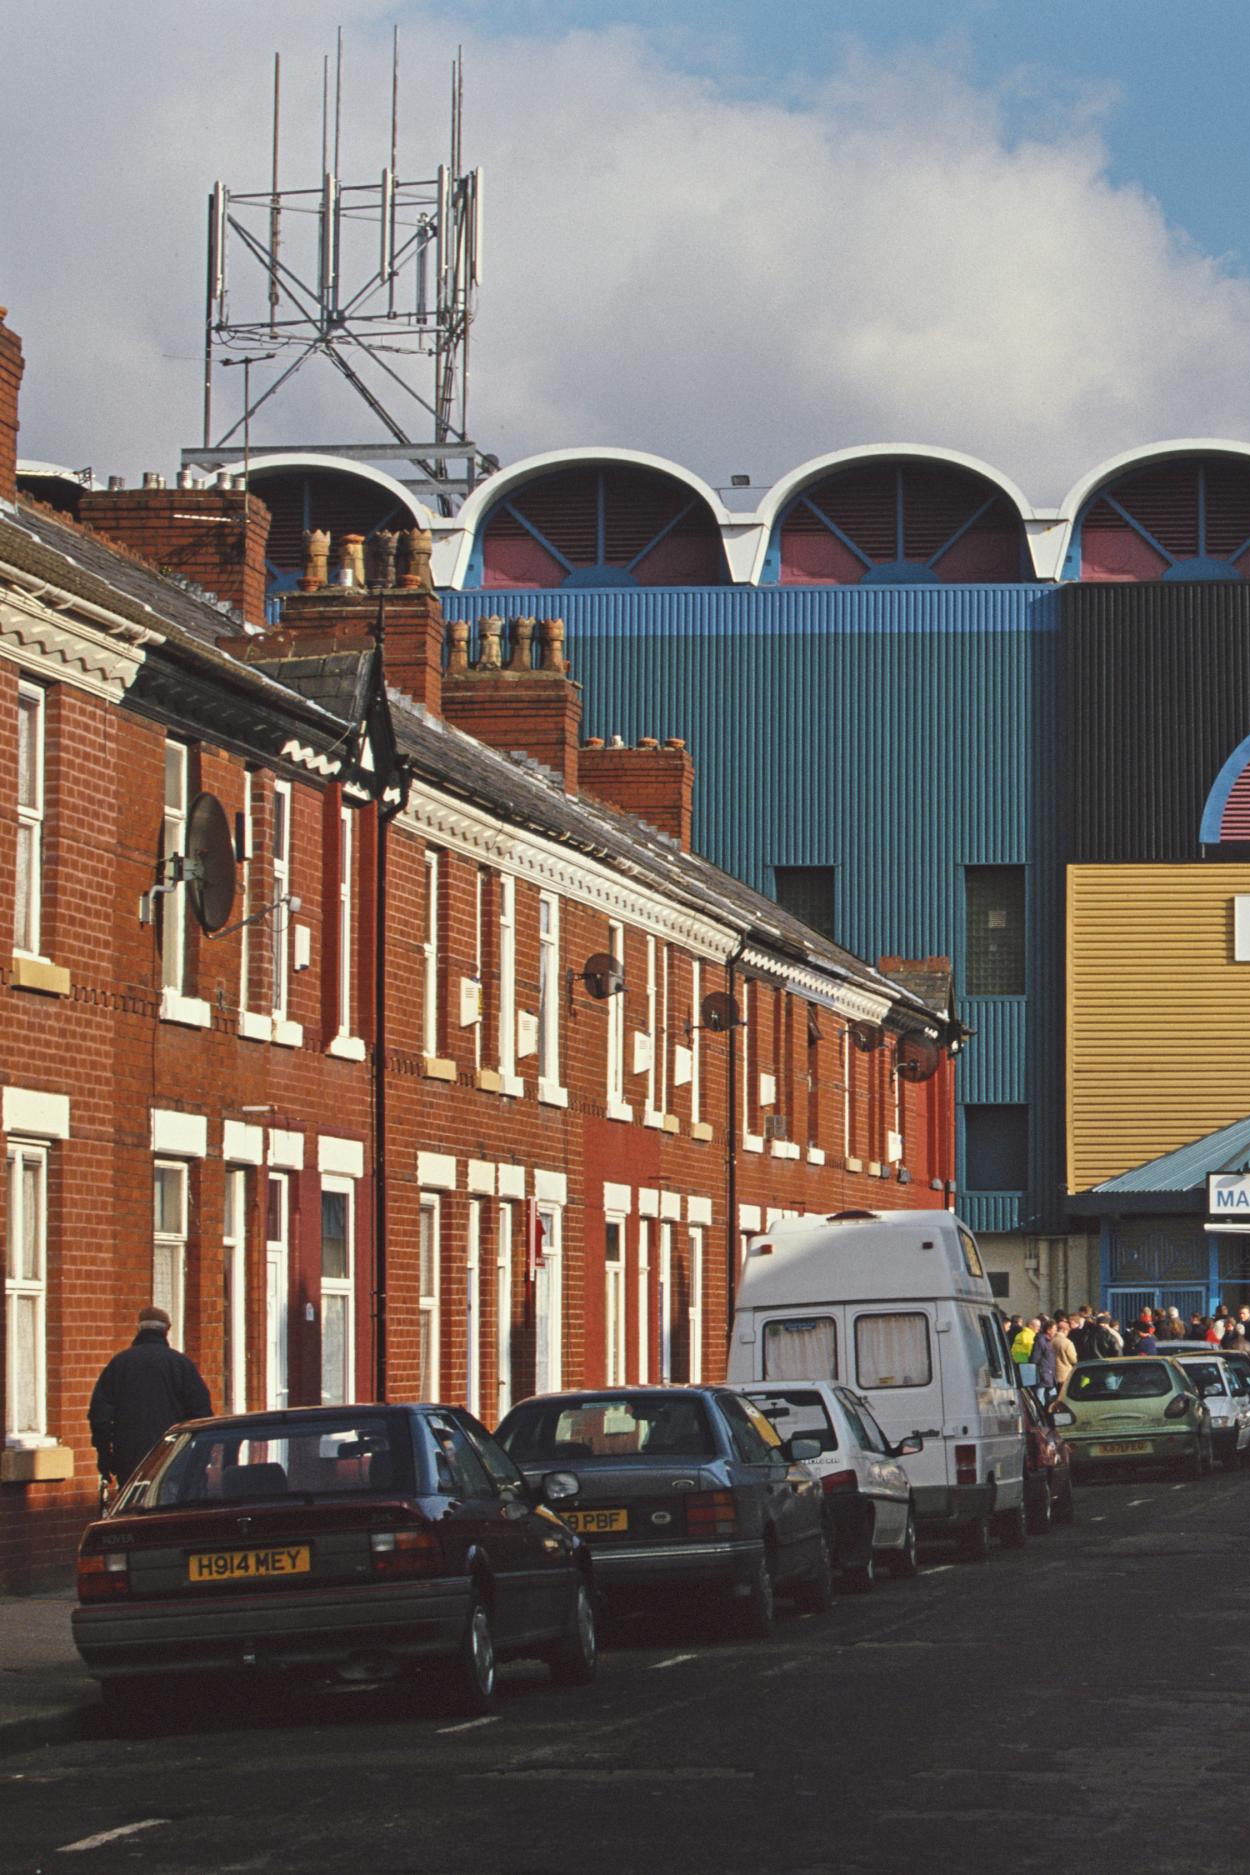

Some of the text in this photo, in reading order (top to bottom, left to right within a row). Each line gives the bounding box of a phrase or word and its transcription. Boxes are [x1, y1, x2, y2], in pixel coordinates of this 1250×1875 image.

[583, 1511, 621, 1528] PBF
[197, 1549, 302, 1577] H914 MEY
